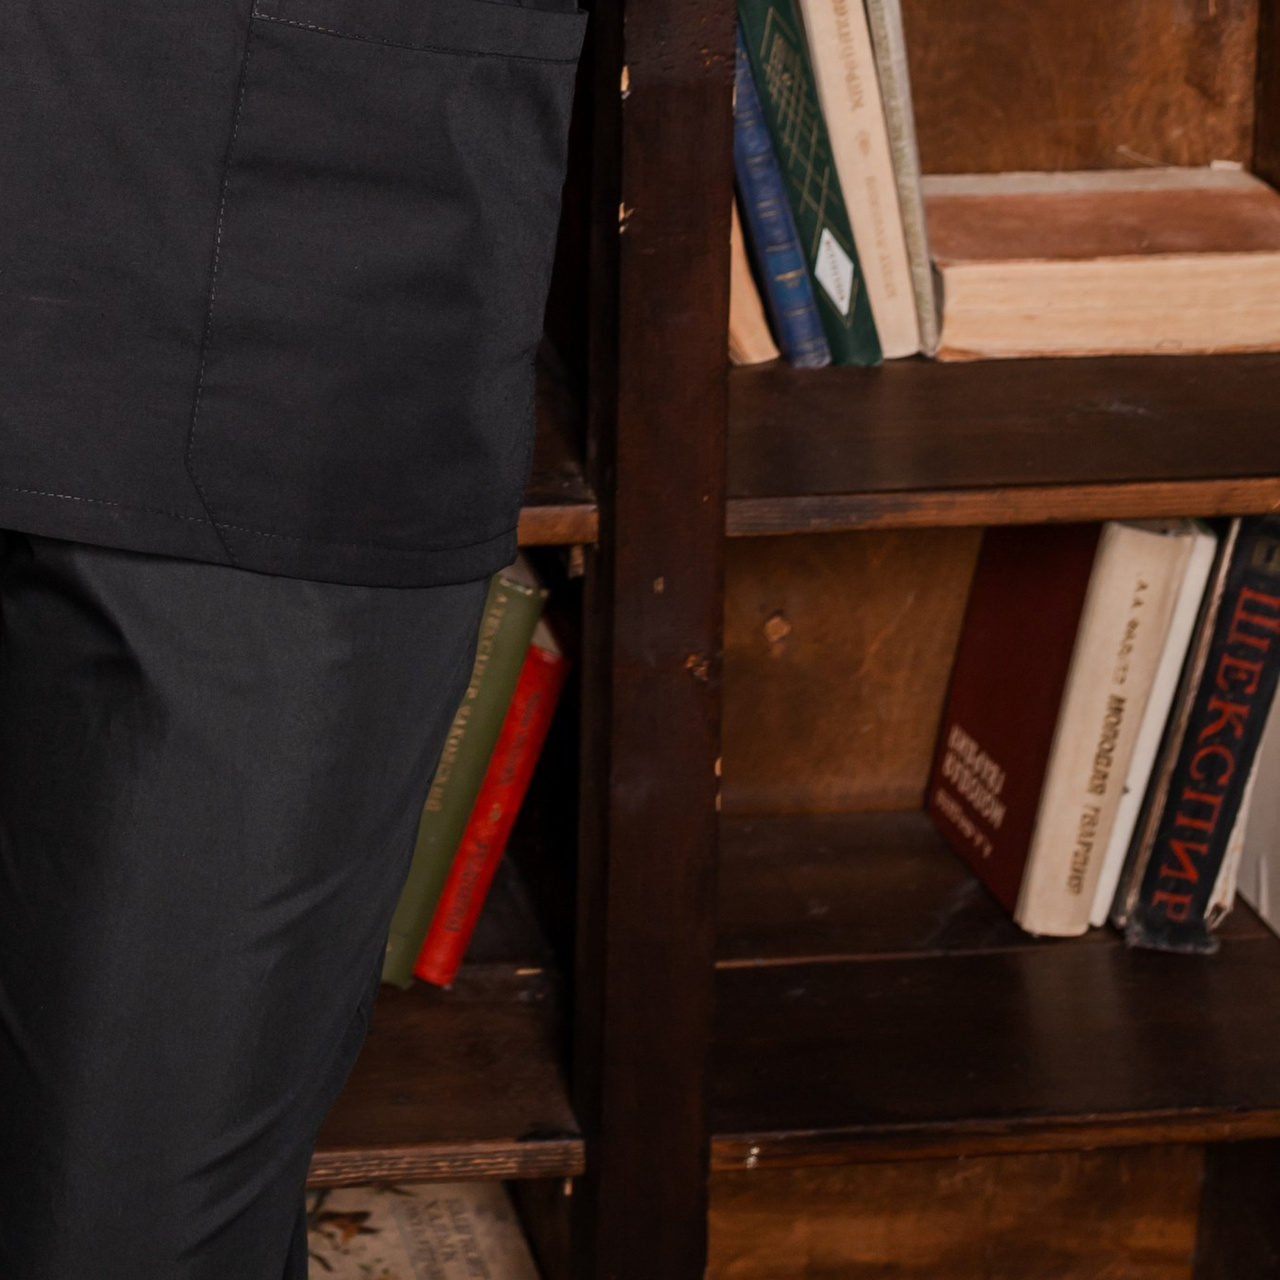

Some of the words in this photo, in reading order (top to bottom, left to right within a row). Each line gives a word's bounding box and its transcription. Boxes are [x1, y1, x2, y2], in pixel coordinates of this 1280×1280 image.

[1087, 693, 1128, 797] МОЛОДАЯ
[1151, 587, 1280, 923] ШЕКСПИР
[1067, 800, 1102, 896] ГВАРДИЯ
